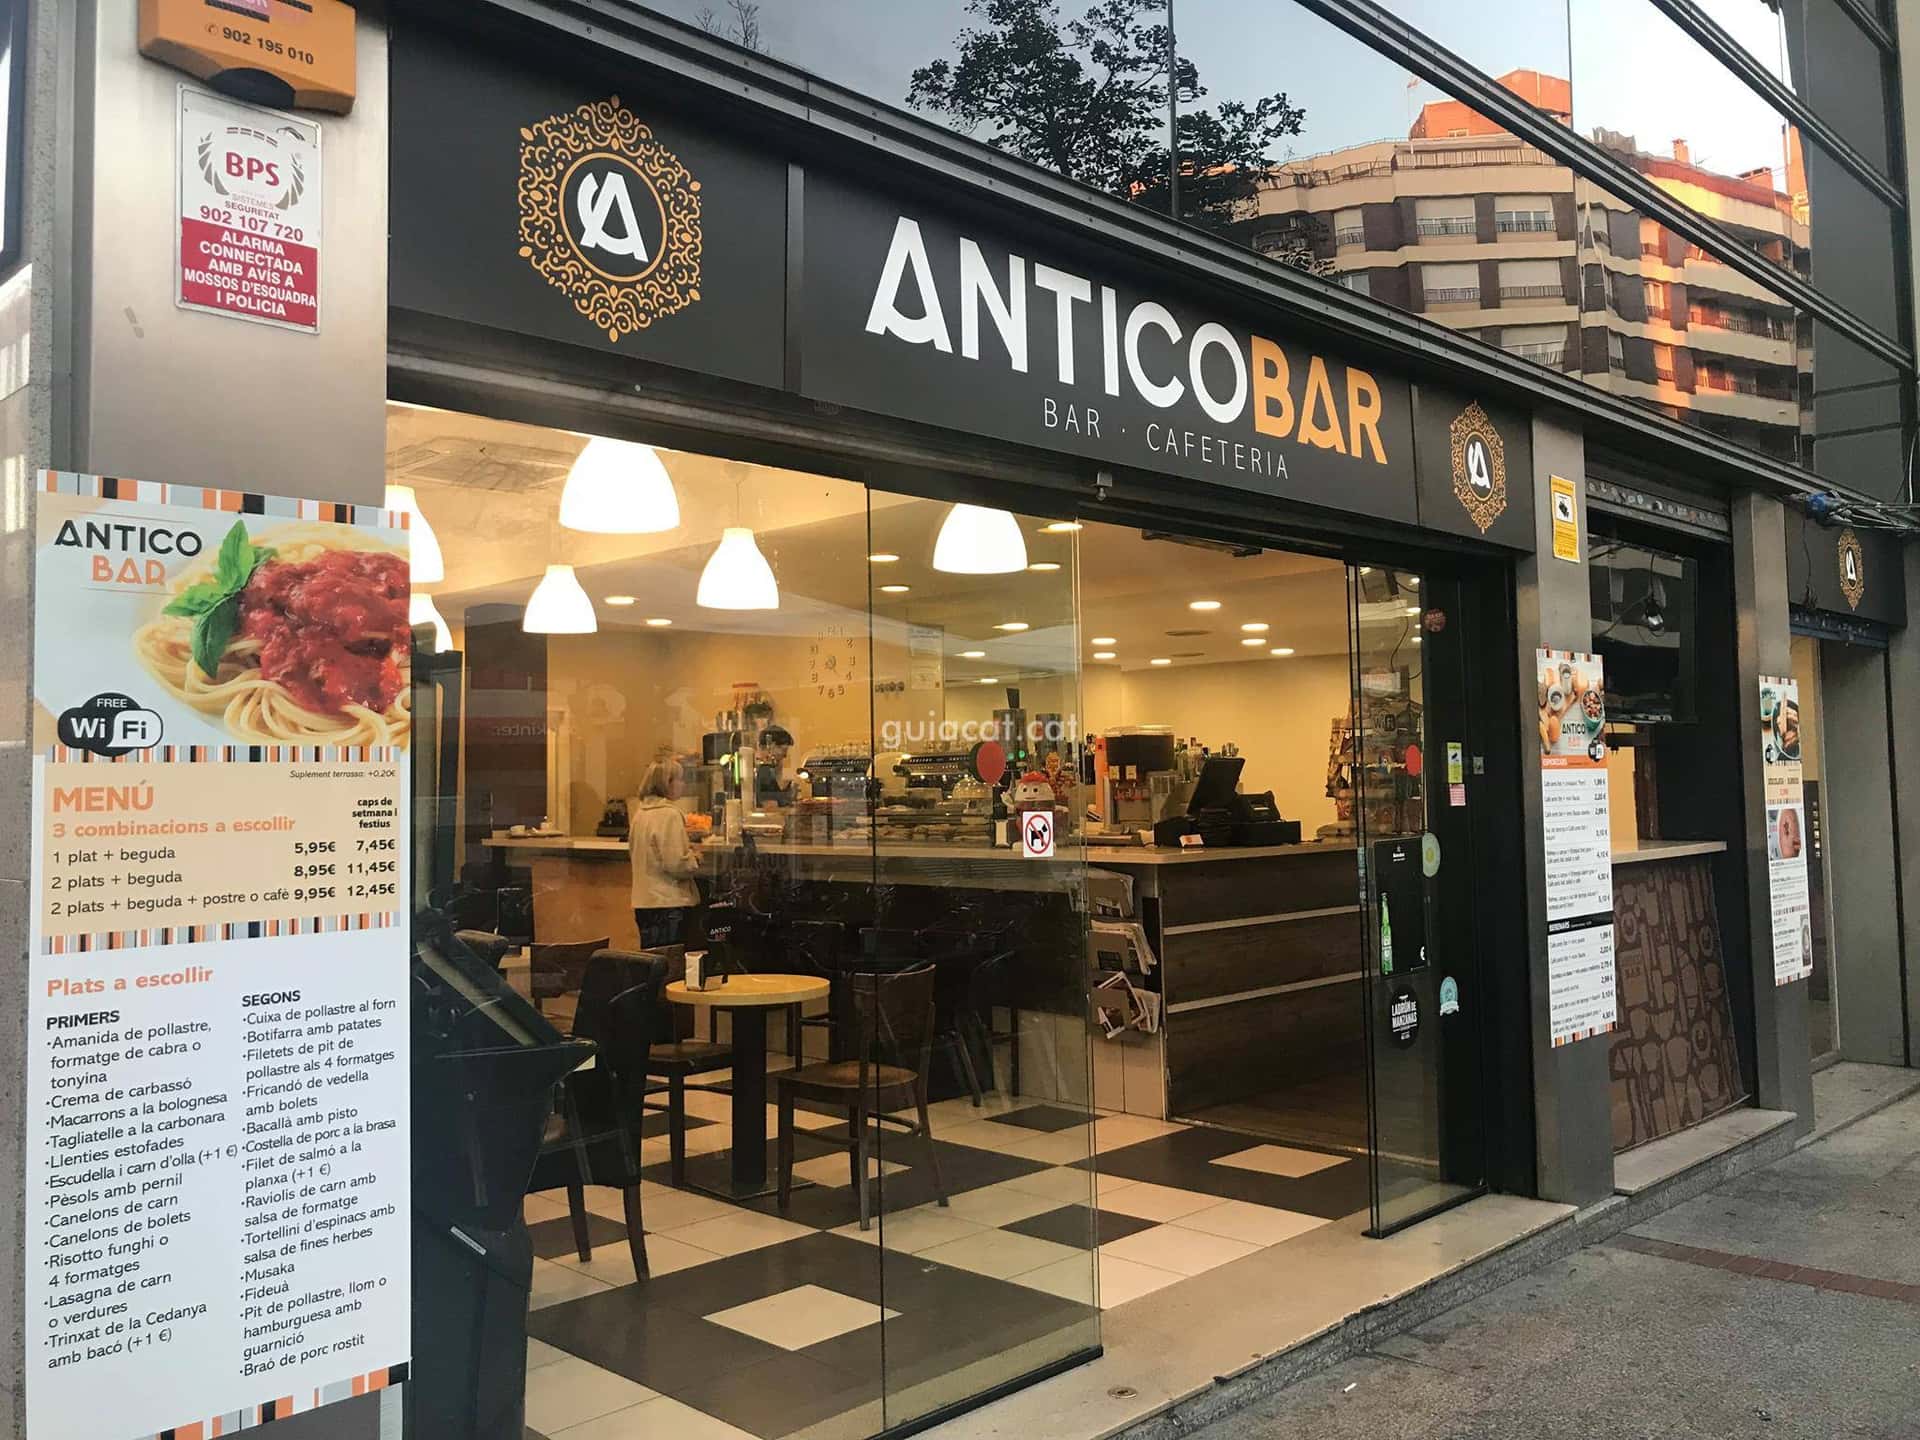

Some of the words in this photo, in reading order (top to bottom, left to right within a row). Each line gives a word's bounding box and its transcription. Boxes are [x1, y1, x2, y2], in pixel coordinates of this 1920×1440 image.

[222, 27, 251, 45] 902
[257, 37, 283, 55] 195
[288, 47, 314, 65] 010
[226, 151, 280, 186] BPS
[200, 205, 232, 225] 902
[239, 215, 269, 233] 107
[274, 223, 304, 241] 720
[225, 200, 280, 220] SEGURETAT
[200, 240, 303, 275] CONNECTADA
[222, 230, 285, 256] ALARMA
[184, 268, 239, 291] MOSSOS
[242, 280, 317, 307] D'ESQUADRA
[208, 258, 243, 276] AMB
[247, 267, 281, 285] AVÍS
[285, 275, 295, 288] A
[216, 290, 221, 303] I
[226, 292, 287, 316] POLICIA
[1044, 396, 1102, 439] BAR
[1146, 423, 1289, 480] CAFETERIA
[54, 519, 202, 557] ANTICO
[96, 698, 128, 708] FREE
[289, 770, 331, 780] Suplement
[53, 780, 154, 813] MENÚ
[357, 799, 379, 807] caps
[380, 797, 393, 806] de
[53, 823, 66, 838] 3
[75, 820, 208, 838] combinacions
[215, 822, 226, 833] a
[233, 816, 296, 832] escollir
[352, 809, 393, 818] setmana
[359, 820, 391, 829] festius
[53, 851, 60, 863] 1
[68, 849, 97, 866] plat
[120, 847, 176, 863] beguda
[294, 841, 336, 855] 5,95€
[356, 839, 395, 853] 7,45€
[51, 876, 62, 889] 2
[67, 874, 105, 892] plats
[127, 871, 182, 887] beguda
[294, 864, 336, 878] 8,95€
[347, 862, 395, 876] 11,45€
[51, 902, 61, 915] 2
[67, 899, 105, 917] plats
[127, 896, 182, 912] beguda
[202, 892, 246, 907] postre
[250, 893, 259, 902] o
[294, 887, 336, 901] 9,95€
[347, 884, 395, 897] 12,45€
[48, 978, 104, 996] Plats
[114, 978, 126, 990] a
[136, 966, 212, 988] escollir
[242, 990, 301, 1008] SEGONS
[247, 1011, 282, 1025] Cuixa
[285, 1008, 301, 1021] de
[305, 1004, 356, 1022] pollastre
[359, 1000, 369, 1013] al
[372, 998, 396, 1011] forn
[46, 1010, 120, 1031] PRIMERS
[247, 1027, 303, 1043] Botifarra
[306, 1022, 334, 1036] amb
[338, 1018, 382, 1035] patates
[51, 1030, 120, 1050] Amanida
[124, 1027, 143, 1041] de
[148, 1022, 211, 1042] pollastre,
[247, 1046, 294, 1062] Filetets
[298, 1042, 314, 1055] de
[318, 1039, 334, 1055] pit
[338, 1037, 354, 1050] de
[50, 1051, 120, 1070] formatge
[125, 1046, 144, 1060] de
[148, 1042, 188, 1057] cabra
[192, 1041, 201, 1051] o
[246, 1064, 300, 1083] pollastre
[303, 1059, 321, 1072] als
[324, 1057, 333, 1069] 4
[336, 1051, 395, 1067] formatges
[50, 1071, 108, 1090] tonyina
[51, 1093, 100, 1109] Crema
[105, 1087, 124, 1101] de
[128, 1077, 192, 1098] carbassó
[247, 1078, 303, 1098] Fricandó
[306, 1076, 323, 1089] de
[326, 1070, 369, 1086] vedella
[246, 1101, 274, 1117] amb
[279, 1096, 318, 1111] bolets
[246, 1116, 293, 1135] Bacallà
[296, 1111, 324, 1127] amb
[328, 1108, 358, 1125] pisto
[49, 1126, 124, 1150] Tagliatelle
[128, 1126, 137, 1137] a
[141, 1121, 154, 1134] la
[157, 1112, 225, 1132] carbonara
[51, 1149, 109, 1169] Llenties
[114, 1136, 184, 1158] estofades
[50, 1188, 99, 1209] Pèsols
[104, 1181, 136, 1199] amb
[142, 1172, 182, 1196] pernil
[246, 1188, 295, 1209] Raviolis
[299, 1184, 316, 1198] de
[319, 1180, 346, 1194] carn
[350, 1172, 376, 1188] amb
[49, 1206, 119, 1228] Canelons
[124, 1200, 143, 1214] de
[147, 1195, 178, 1210] carn
[244, 1211, 278, 1228] salsa
[281, 1206, 298, 1220] de
[302, 1195, 358, 1215] formatge
[244, 1222, 300, 1245] Tortellini
[304, 1211, 367, 1233] d'espinacs
[369, 1203, 395, 1219] amb
[49, 1226, 119, 1248] Canelons
[123, 1220, 143, 1234] de
[147, 1211, 191, 1229] bolets
[244, 1248, 277, 1265] salsa
[280, 1243, 296, 1256] de
[300, 1237, 329, 1252] fines
[332, 1227, 373, 1245] herbes
[245, 1263, 295, 1283] Musaka
[245, 1280, 290, 1302] Fideuà
[48, 1326, 101, 1348] Trinxat
[105, 1321, 124, 1336] de
[129, 1317, 142, 1330] la
[146, 1303, 207, 1326] Cedanya
[244, 1357, 275, 1377] Braó
[279, 1353, 296, 1367] de
[300, 1345, 329, 1365] porc
[333, 1334, 365, 1352] rostit
